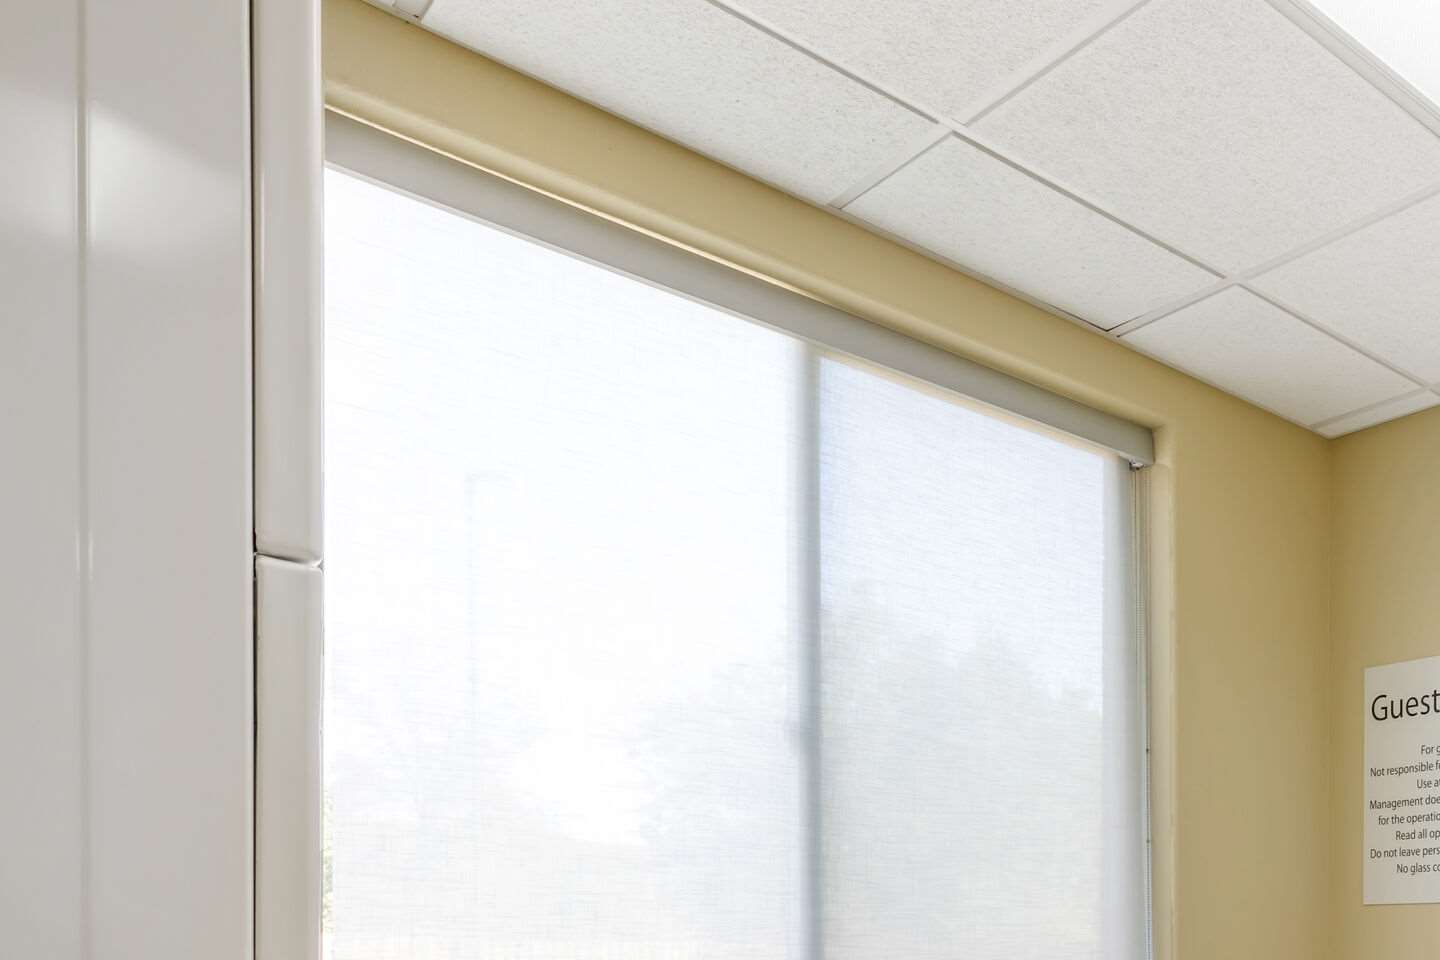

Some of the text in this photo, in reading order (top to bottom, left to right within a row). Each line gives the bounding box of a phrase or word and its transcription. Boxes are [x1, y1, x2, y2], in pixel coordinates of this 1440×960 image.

[1371, 690, 1440, 721] Guest
[1420, 744, 1435, 755] For
[1370, 767, 1385, 777] Not
[1386, 761, 1434, 776] responsible
[1416, 779, 1432, 789] Use
[1369, 796, 1424, 811] Management
[1378, 815, 1390, 826] for
[1391, 813, 1405, 825] the
[1395, 829, 1416, 841] Read
[1417, 828, 1428, 839] all
[1369, 848, 1382, 859] Do
[1383, 848, 1398, 858] not
[1399, 846, 1421, 857] leave
[1396, 863, 1409, 874] No
[1410, 862, 1431, 876] glass
